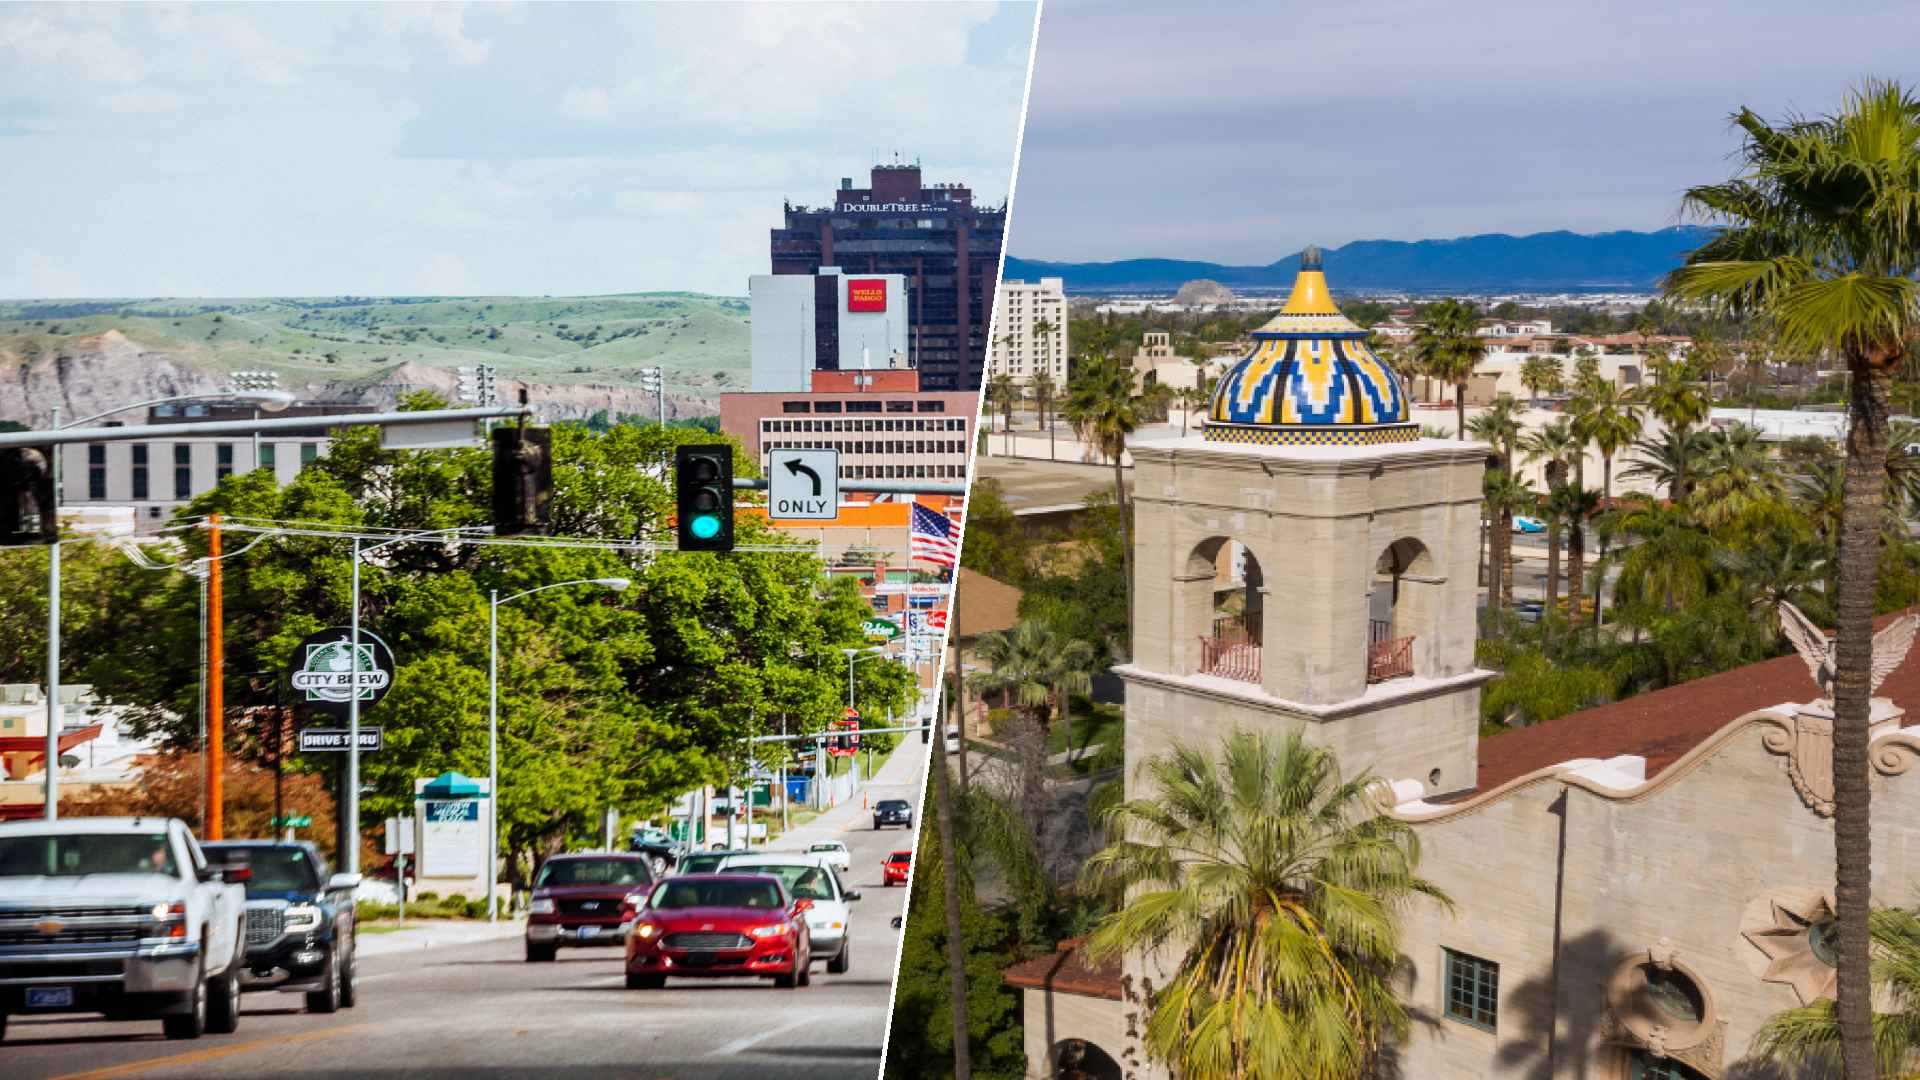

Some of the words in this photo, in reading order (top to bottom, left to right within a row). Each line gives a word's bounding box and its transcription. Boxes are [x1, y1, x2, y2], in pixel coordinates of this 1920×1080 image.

[778, 499, 827, 513] ONLY
[297, 674, 332, 685] CITY
[304, 735, 342, 746] DRIVE
[343, 734, 377, 745] TRU
